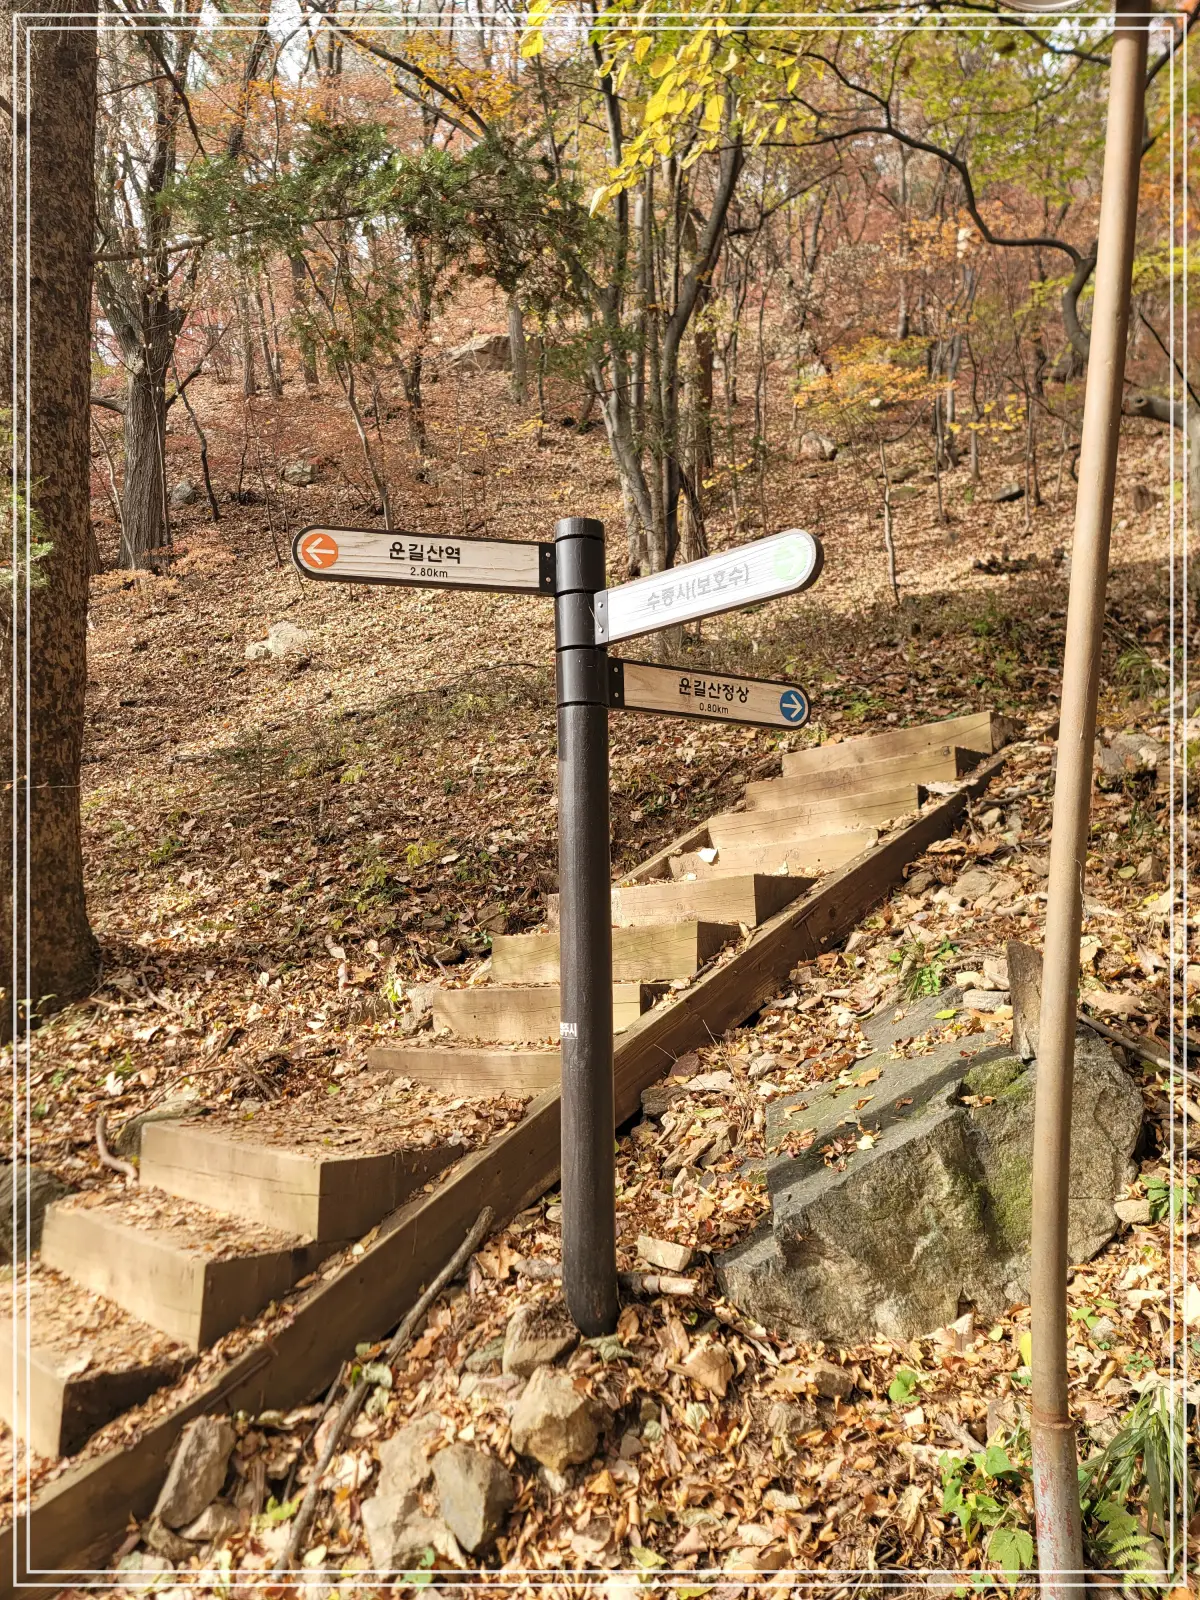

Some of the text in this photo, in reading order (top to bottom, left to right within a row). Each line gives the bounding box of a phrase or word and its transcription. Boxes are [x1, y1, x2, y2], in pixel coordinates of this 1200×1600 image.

[389, 541, 461, 564] 운길산역
[410, 566, 448, 578] 2.80km
[678, 677, 749, 703] 운길산정상
[699, 702, 729, 714] 0.80km
